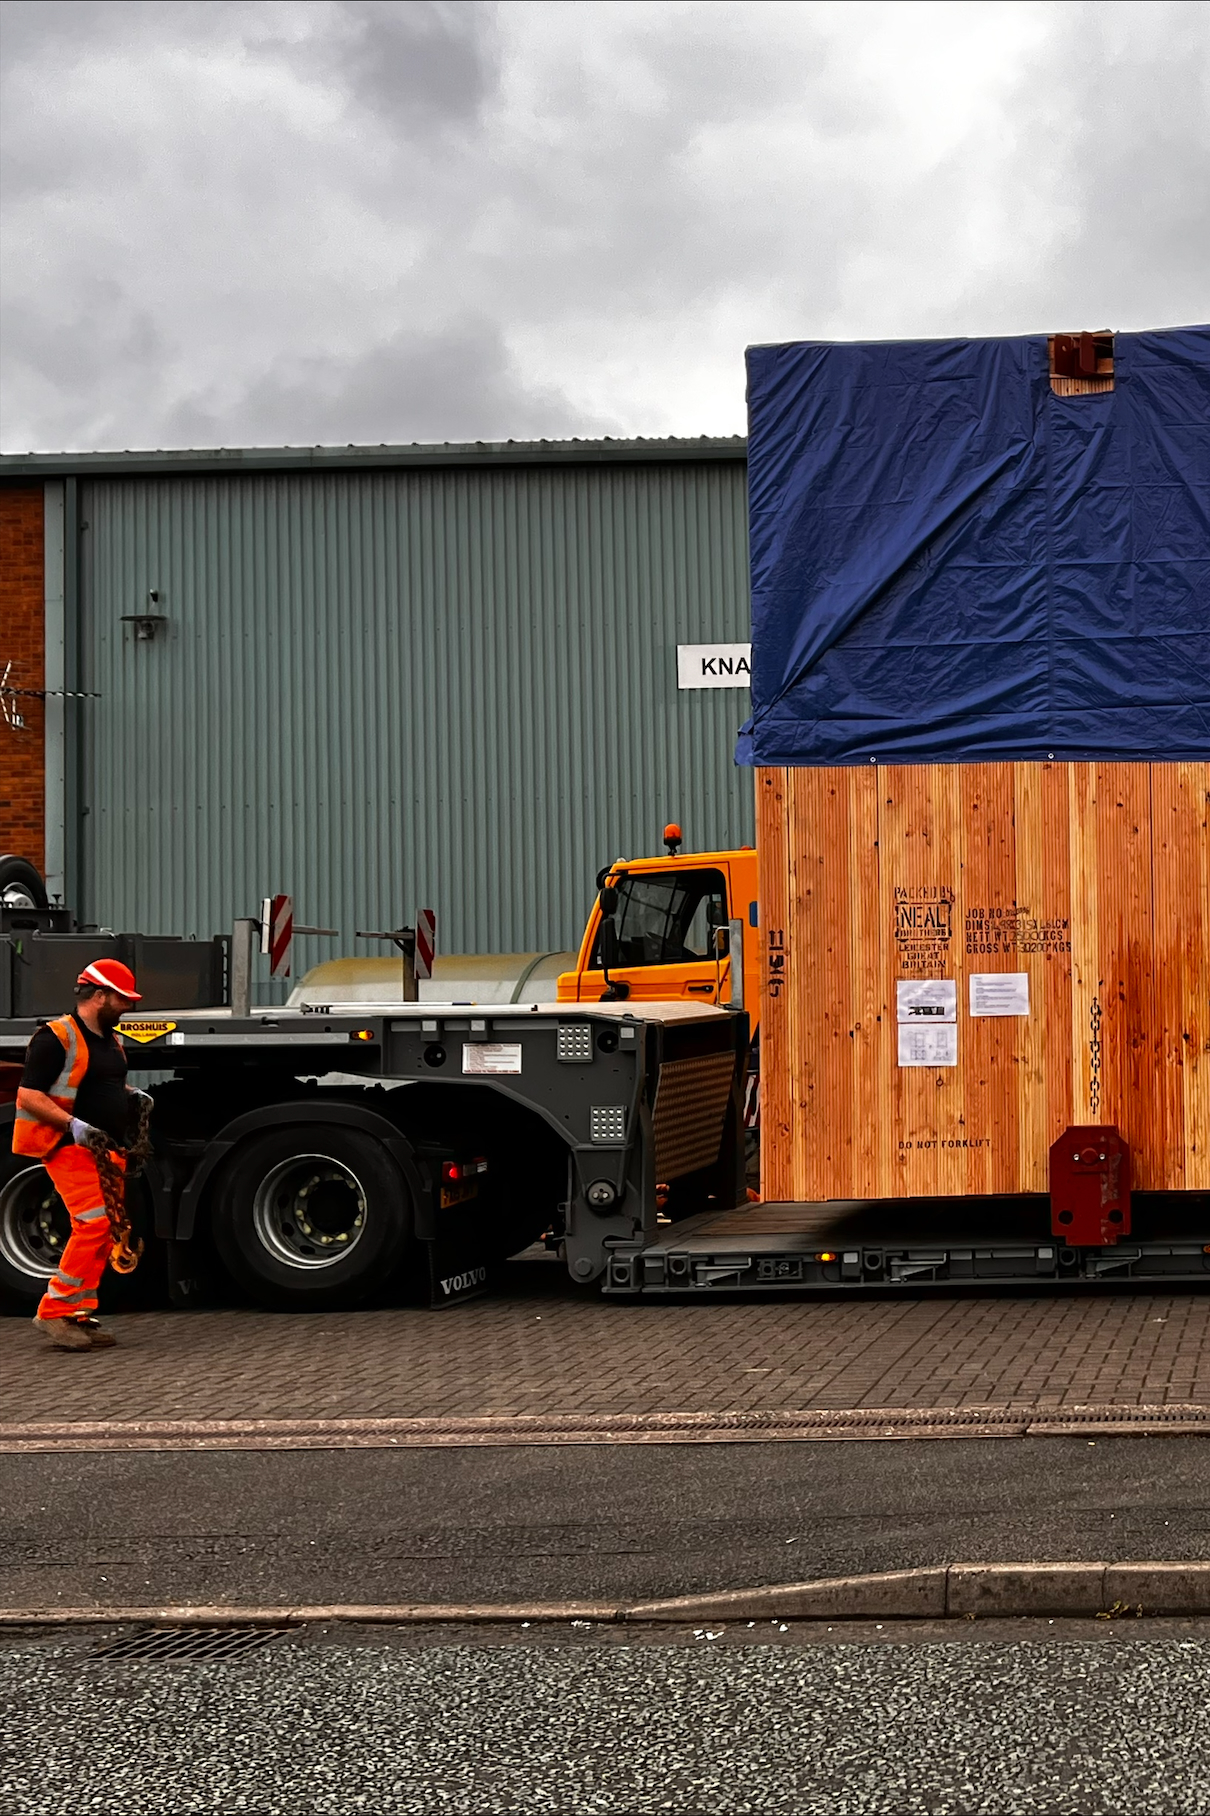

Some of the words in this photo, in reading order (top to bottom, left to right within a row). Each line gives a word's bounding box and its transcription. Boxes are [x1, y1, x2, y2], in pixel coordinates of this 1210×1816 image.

[701, 657, 751, 676] KNA
[894, 886, 937, 899] PACKED
[901, 906, 947, 928] NEAL
[965, 908, 985, 919] JOB
[966, 931, 990, 942] NETT
[966, 942, 999, 954] GROSS
[907, 951, 940, 960] GREAT
[902, 960, 946, 969] BRITAIN
[120, 1023, 168, 1031] BROSHUIS
[898, 1141, 912, 1149] DO
[916, 1140, 938, 1149] NOT
[941, 1138, 991, 1148] FORKLIFT
[440, 1266, 486, 1295] VOLVO
